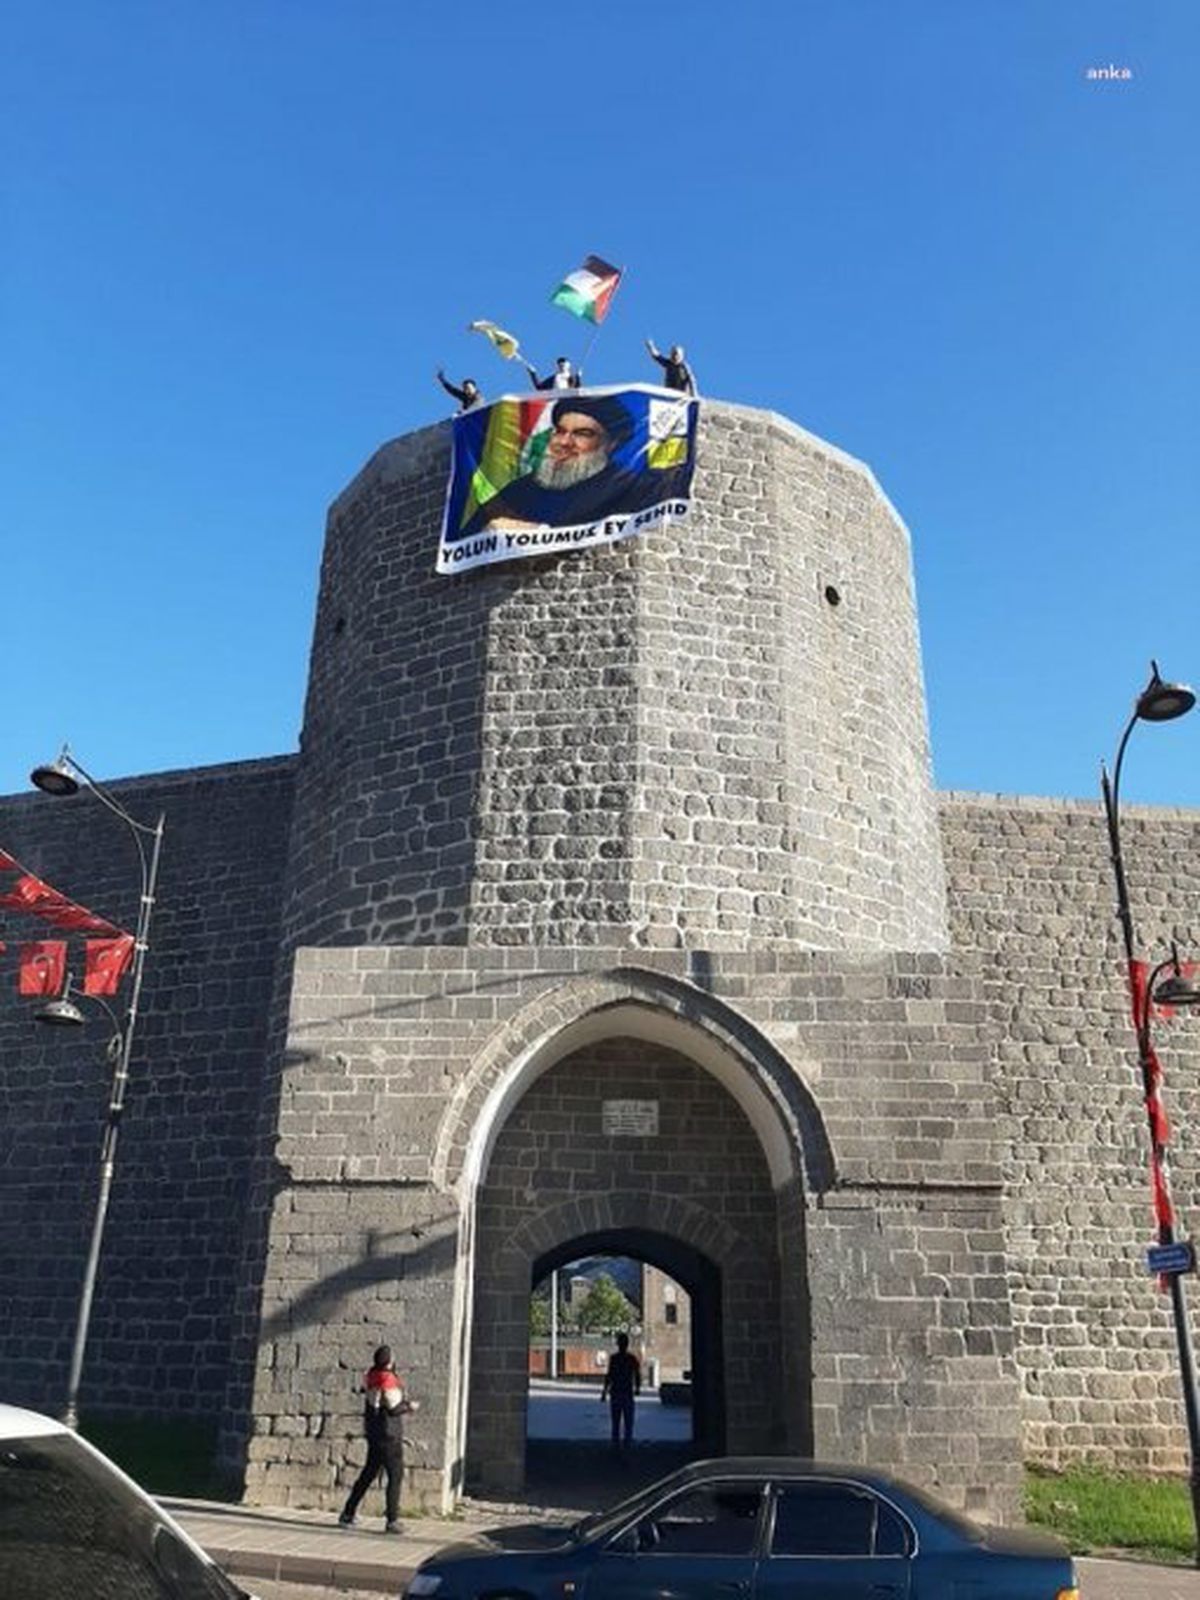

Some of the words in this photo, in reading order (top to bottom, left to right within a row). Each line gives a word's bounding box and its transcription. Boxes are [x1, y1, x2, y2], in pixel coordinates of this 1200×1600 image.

[443, 535, 497, 563] YOLUN
[505, 526, 597, 548] YOLUMUZ
[604, 521, 627, 535] EY
